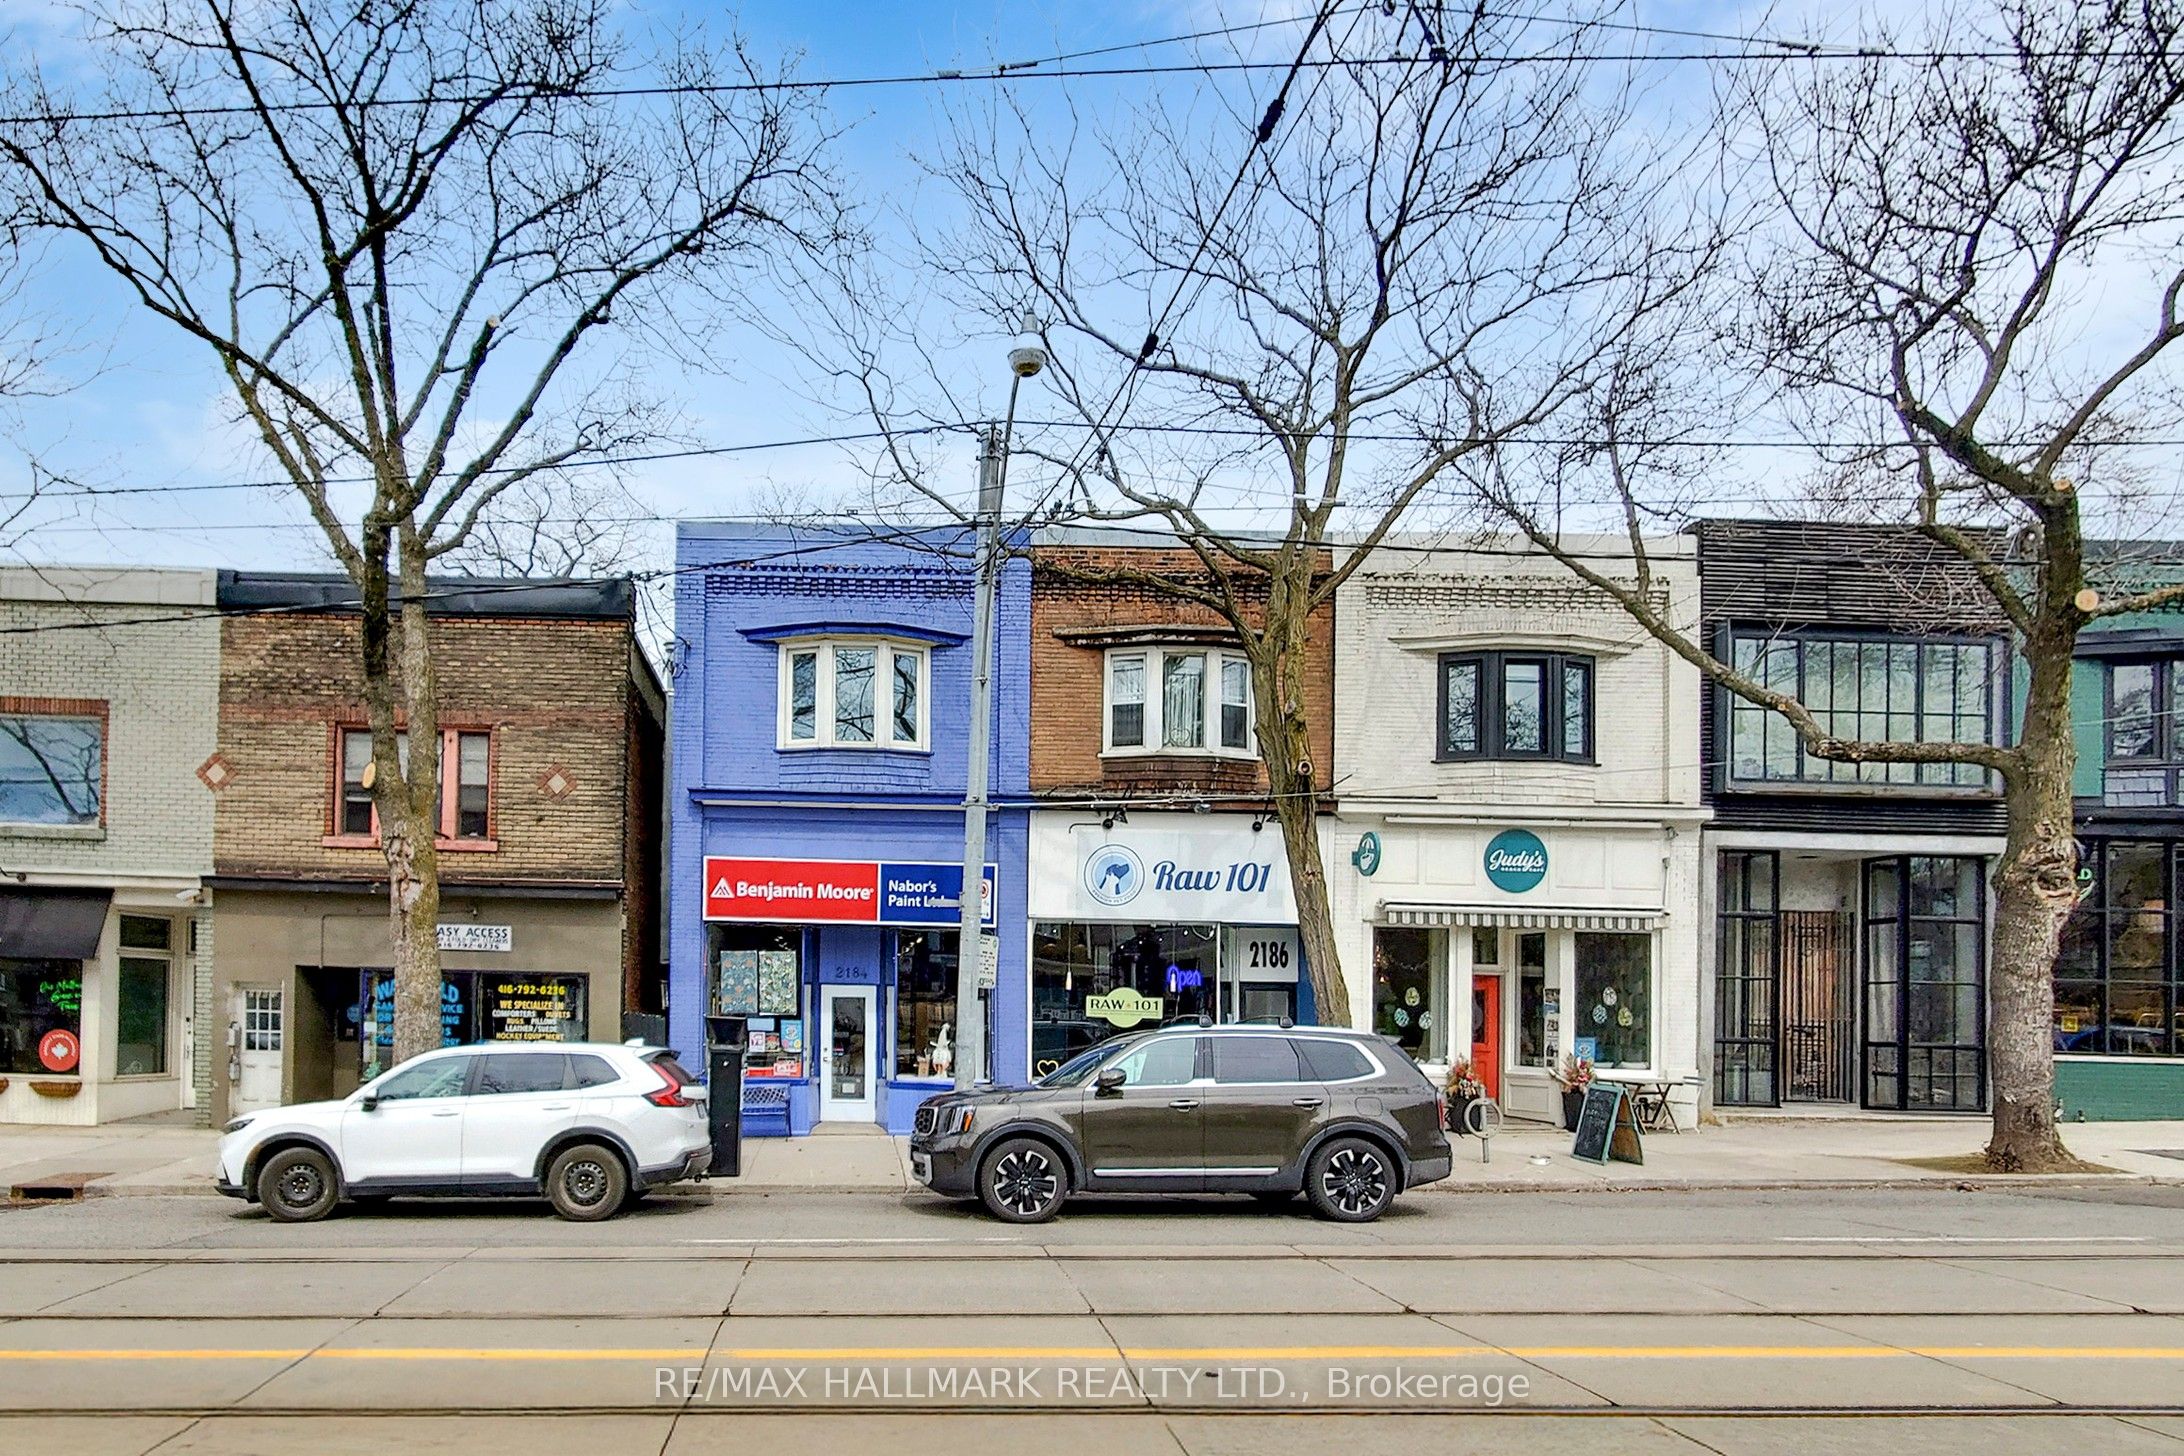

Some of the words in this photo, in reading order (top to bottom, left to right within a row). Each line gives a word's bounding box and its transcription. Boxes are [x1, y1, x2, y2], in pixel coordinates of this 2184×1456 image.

[1489, 849, 1544, 871] Judy's
[1152, 860, 1221, 891] Raw
[1225, 862, 1272, 892] 101
[736, 881, 813, 901] Benjamin
[888, 880, 937, 893] Nabor's
[888, 895, 921, 907] Paint
[436, 927, 459, 938] ASY
[466, 928, 507, 938] ACCESS
[1249, 941, 1289, 969] 2186
[835, 966, 868, 979] 2184
[498, 984, 566, 996] 416-792-6236
[514, 1001, 553, 1010] SPECIALIZE
[1090, 999, 1125, 1010] RAW
[1134, 1001, 1158, 1011] 101
